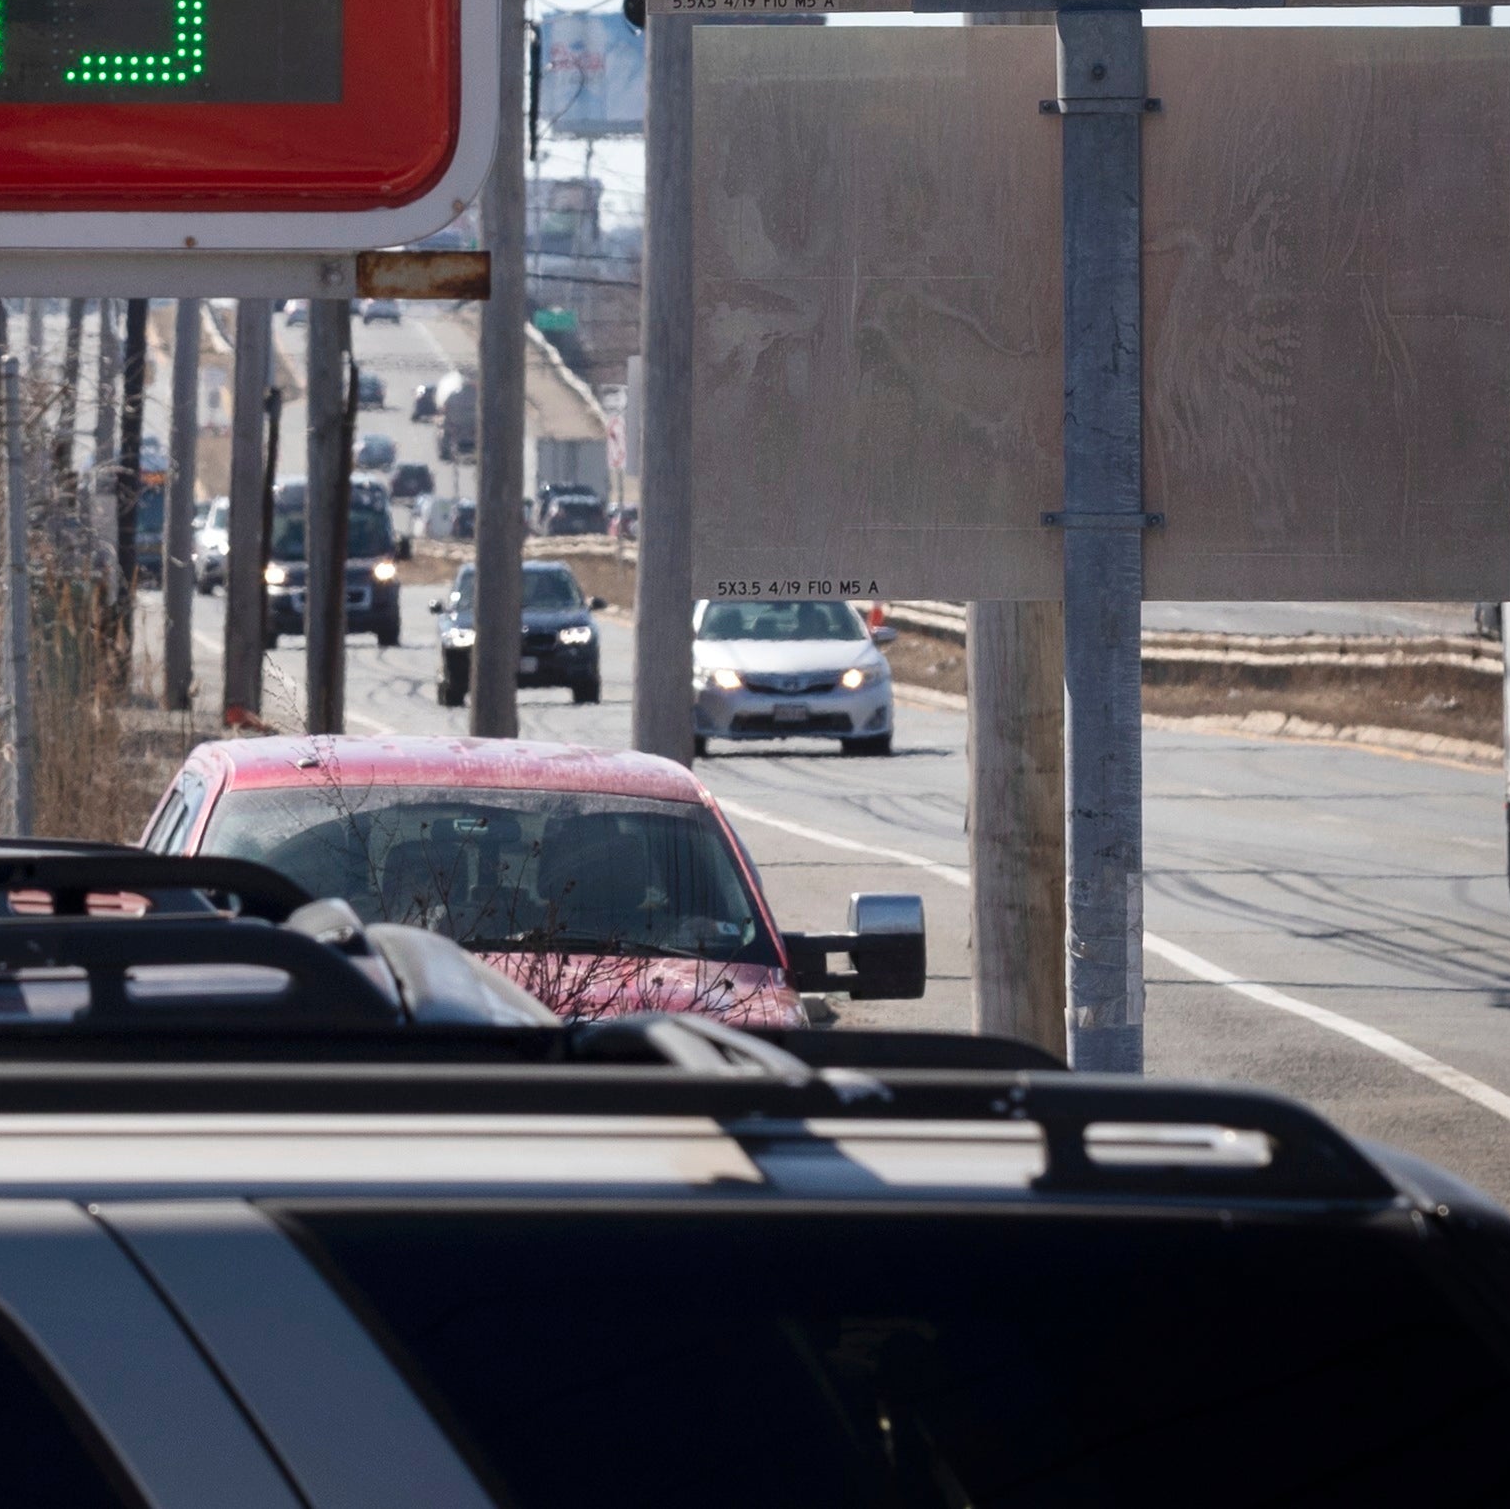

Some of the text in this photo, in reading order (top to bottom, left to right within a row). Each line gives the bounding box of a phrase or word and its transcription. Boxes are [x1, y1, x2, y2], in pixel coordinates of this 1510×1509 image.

[717, 580, 879, 596] 5X3.5 4/19 F10 M5 A
